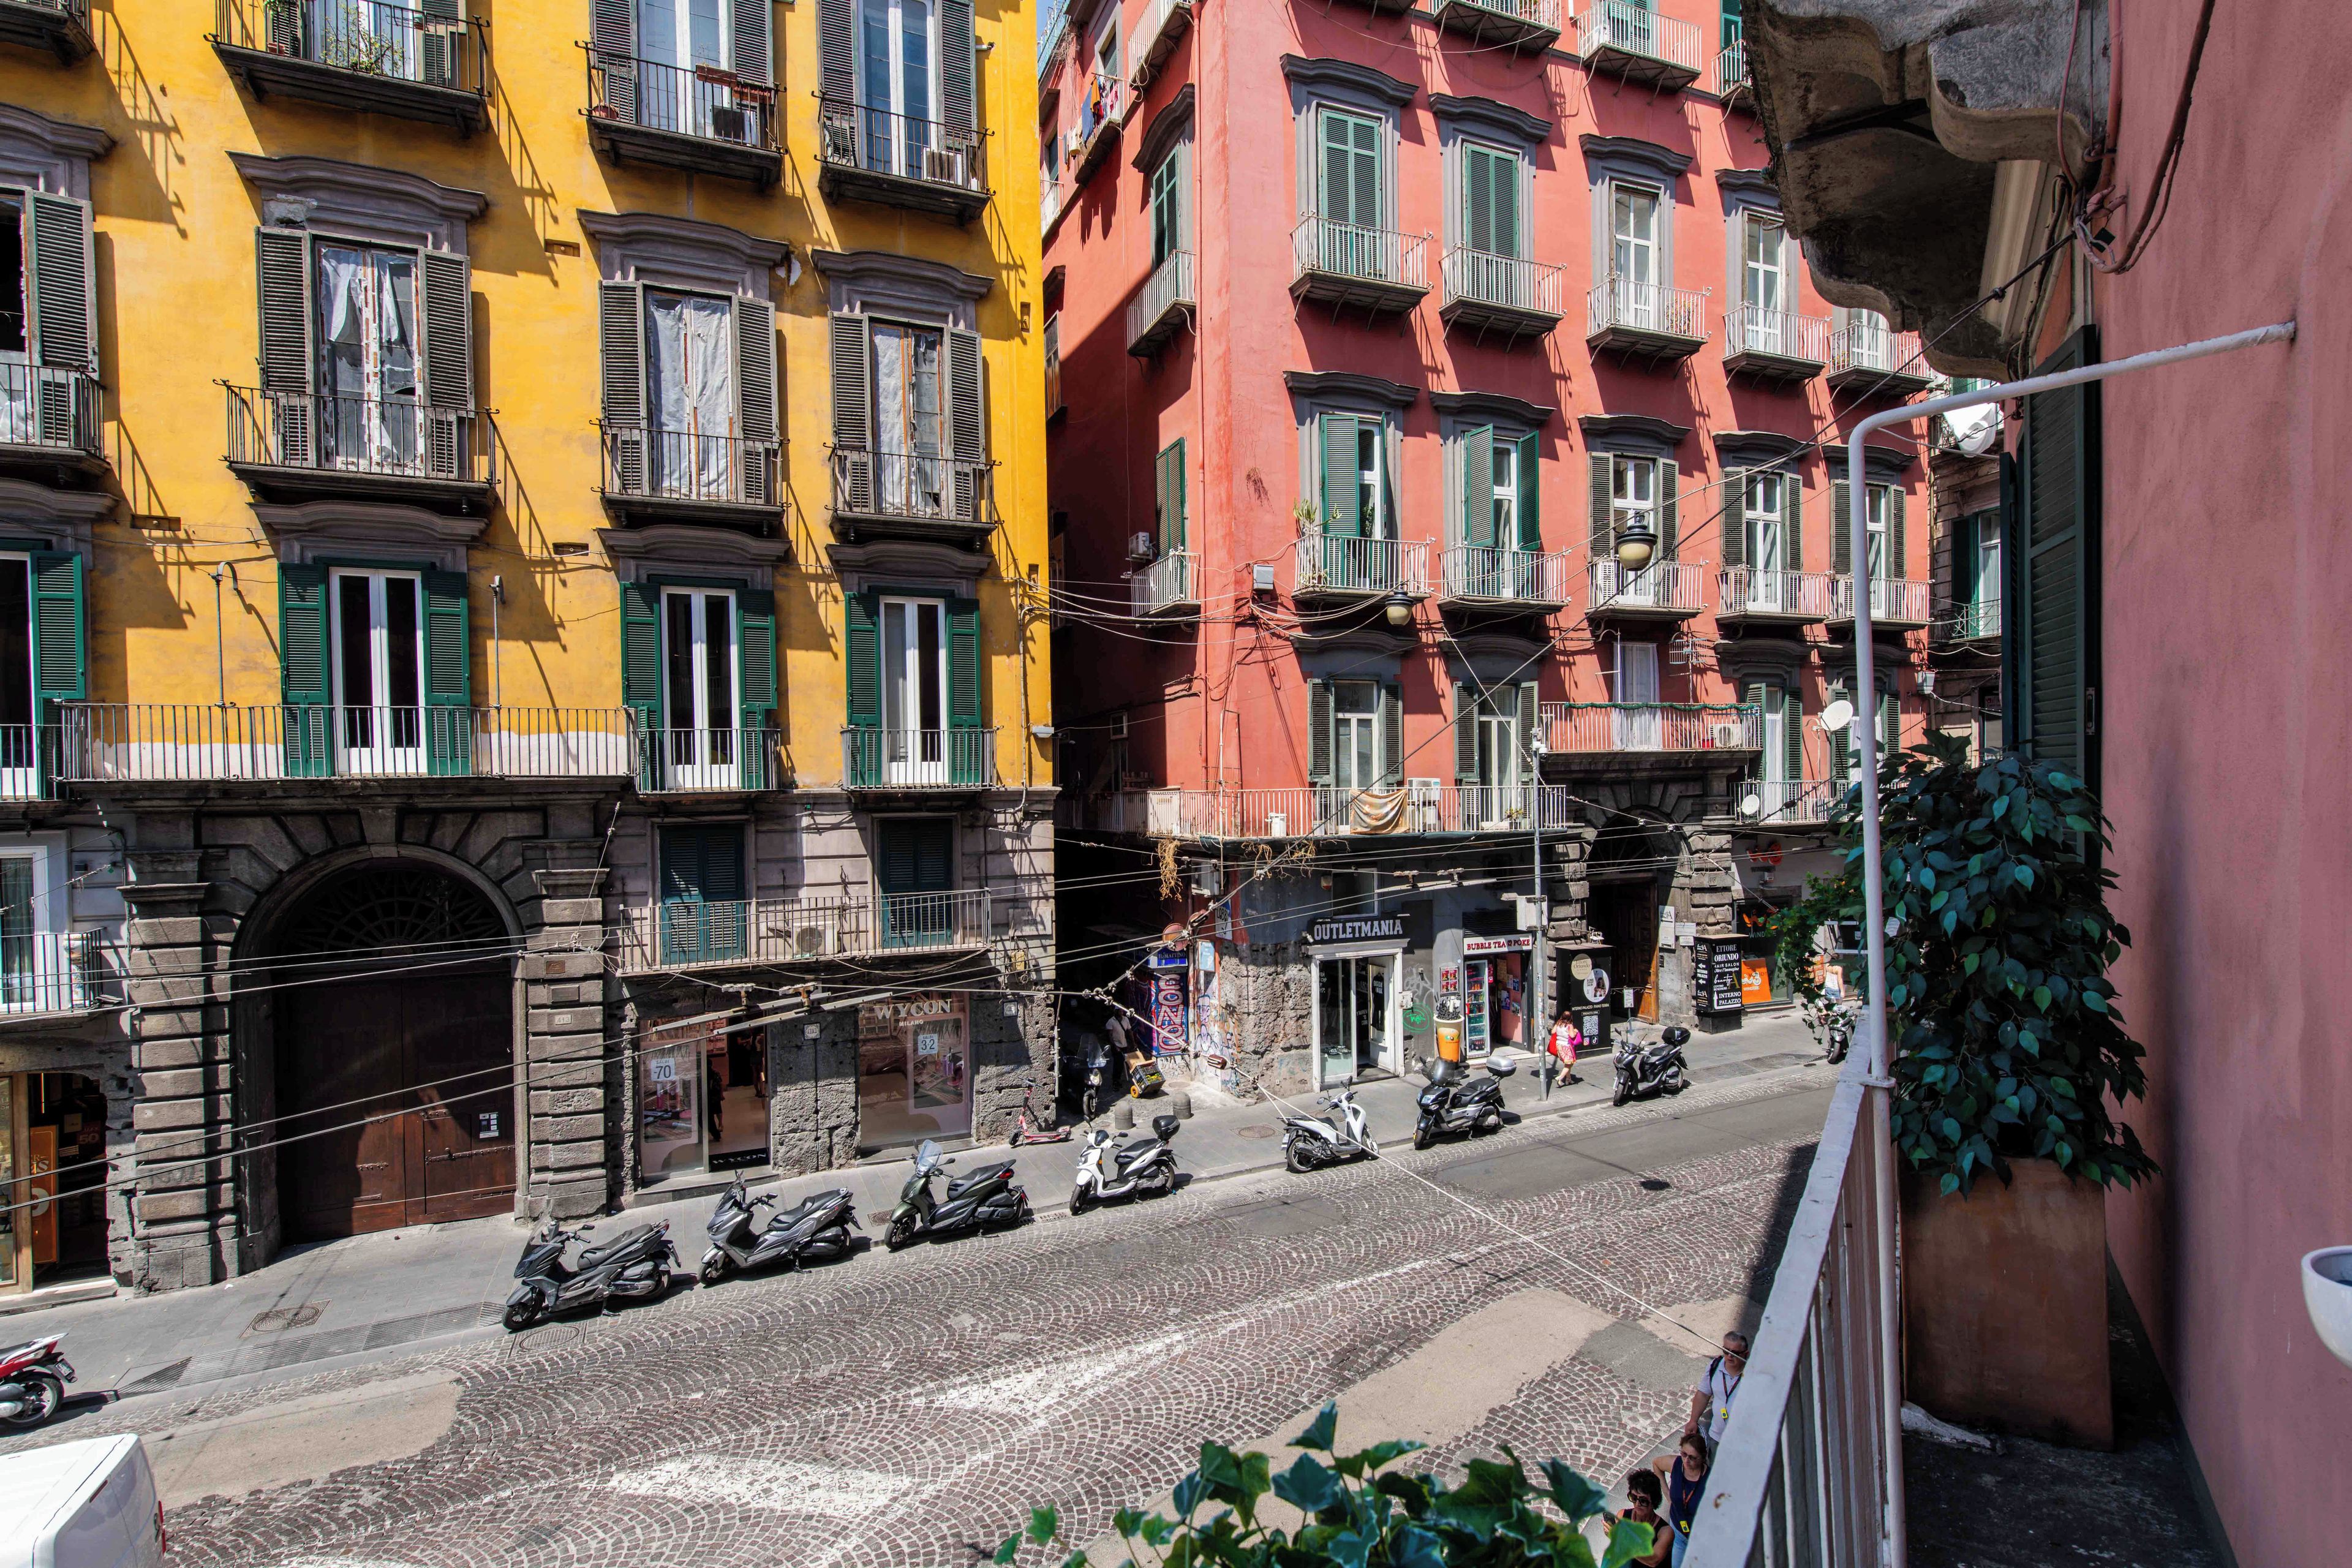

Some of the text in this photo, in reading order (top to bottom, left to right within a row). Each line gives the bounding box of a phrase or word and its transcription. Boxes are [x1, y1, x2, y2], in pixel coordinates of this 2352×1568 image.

[1314, 919, 1403, 941] OUTLETMANIA
[1467, 941, 1492, 951] BUBBLE
[1716, 944, 1737, 952] ETTORE
[1714, 953, 1739, 962] ORIUNDO
[1714, 974, 1733, 986] beauty
[1727, 972, 1740, 989] A
[873, 999, 952, 1020] WYCON
[654, 1065, 671, 1079] -70
[78, 1133, 100, 1145] 50
[712, 1153, 766, 1164] WYCON
